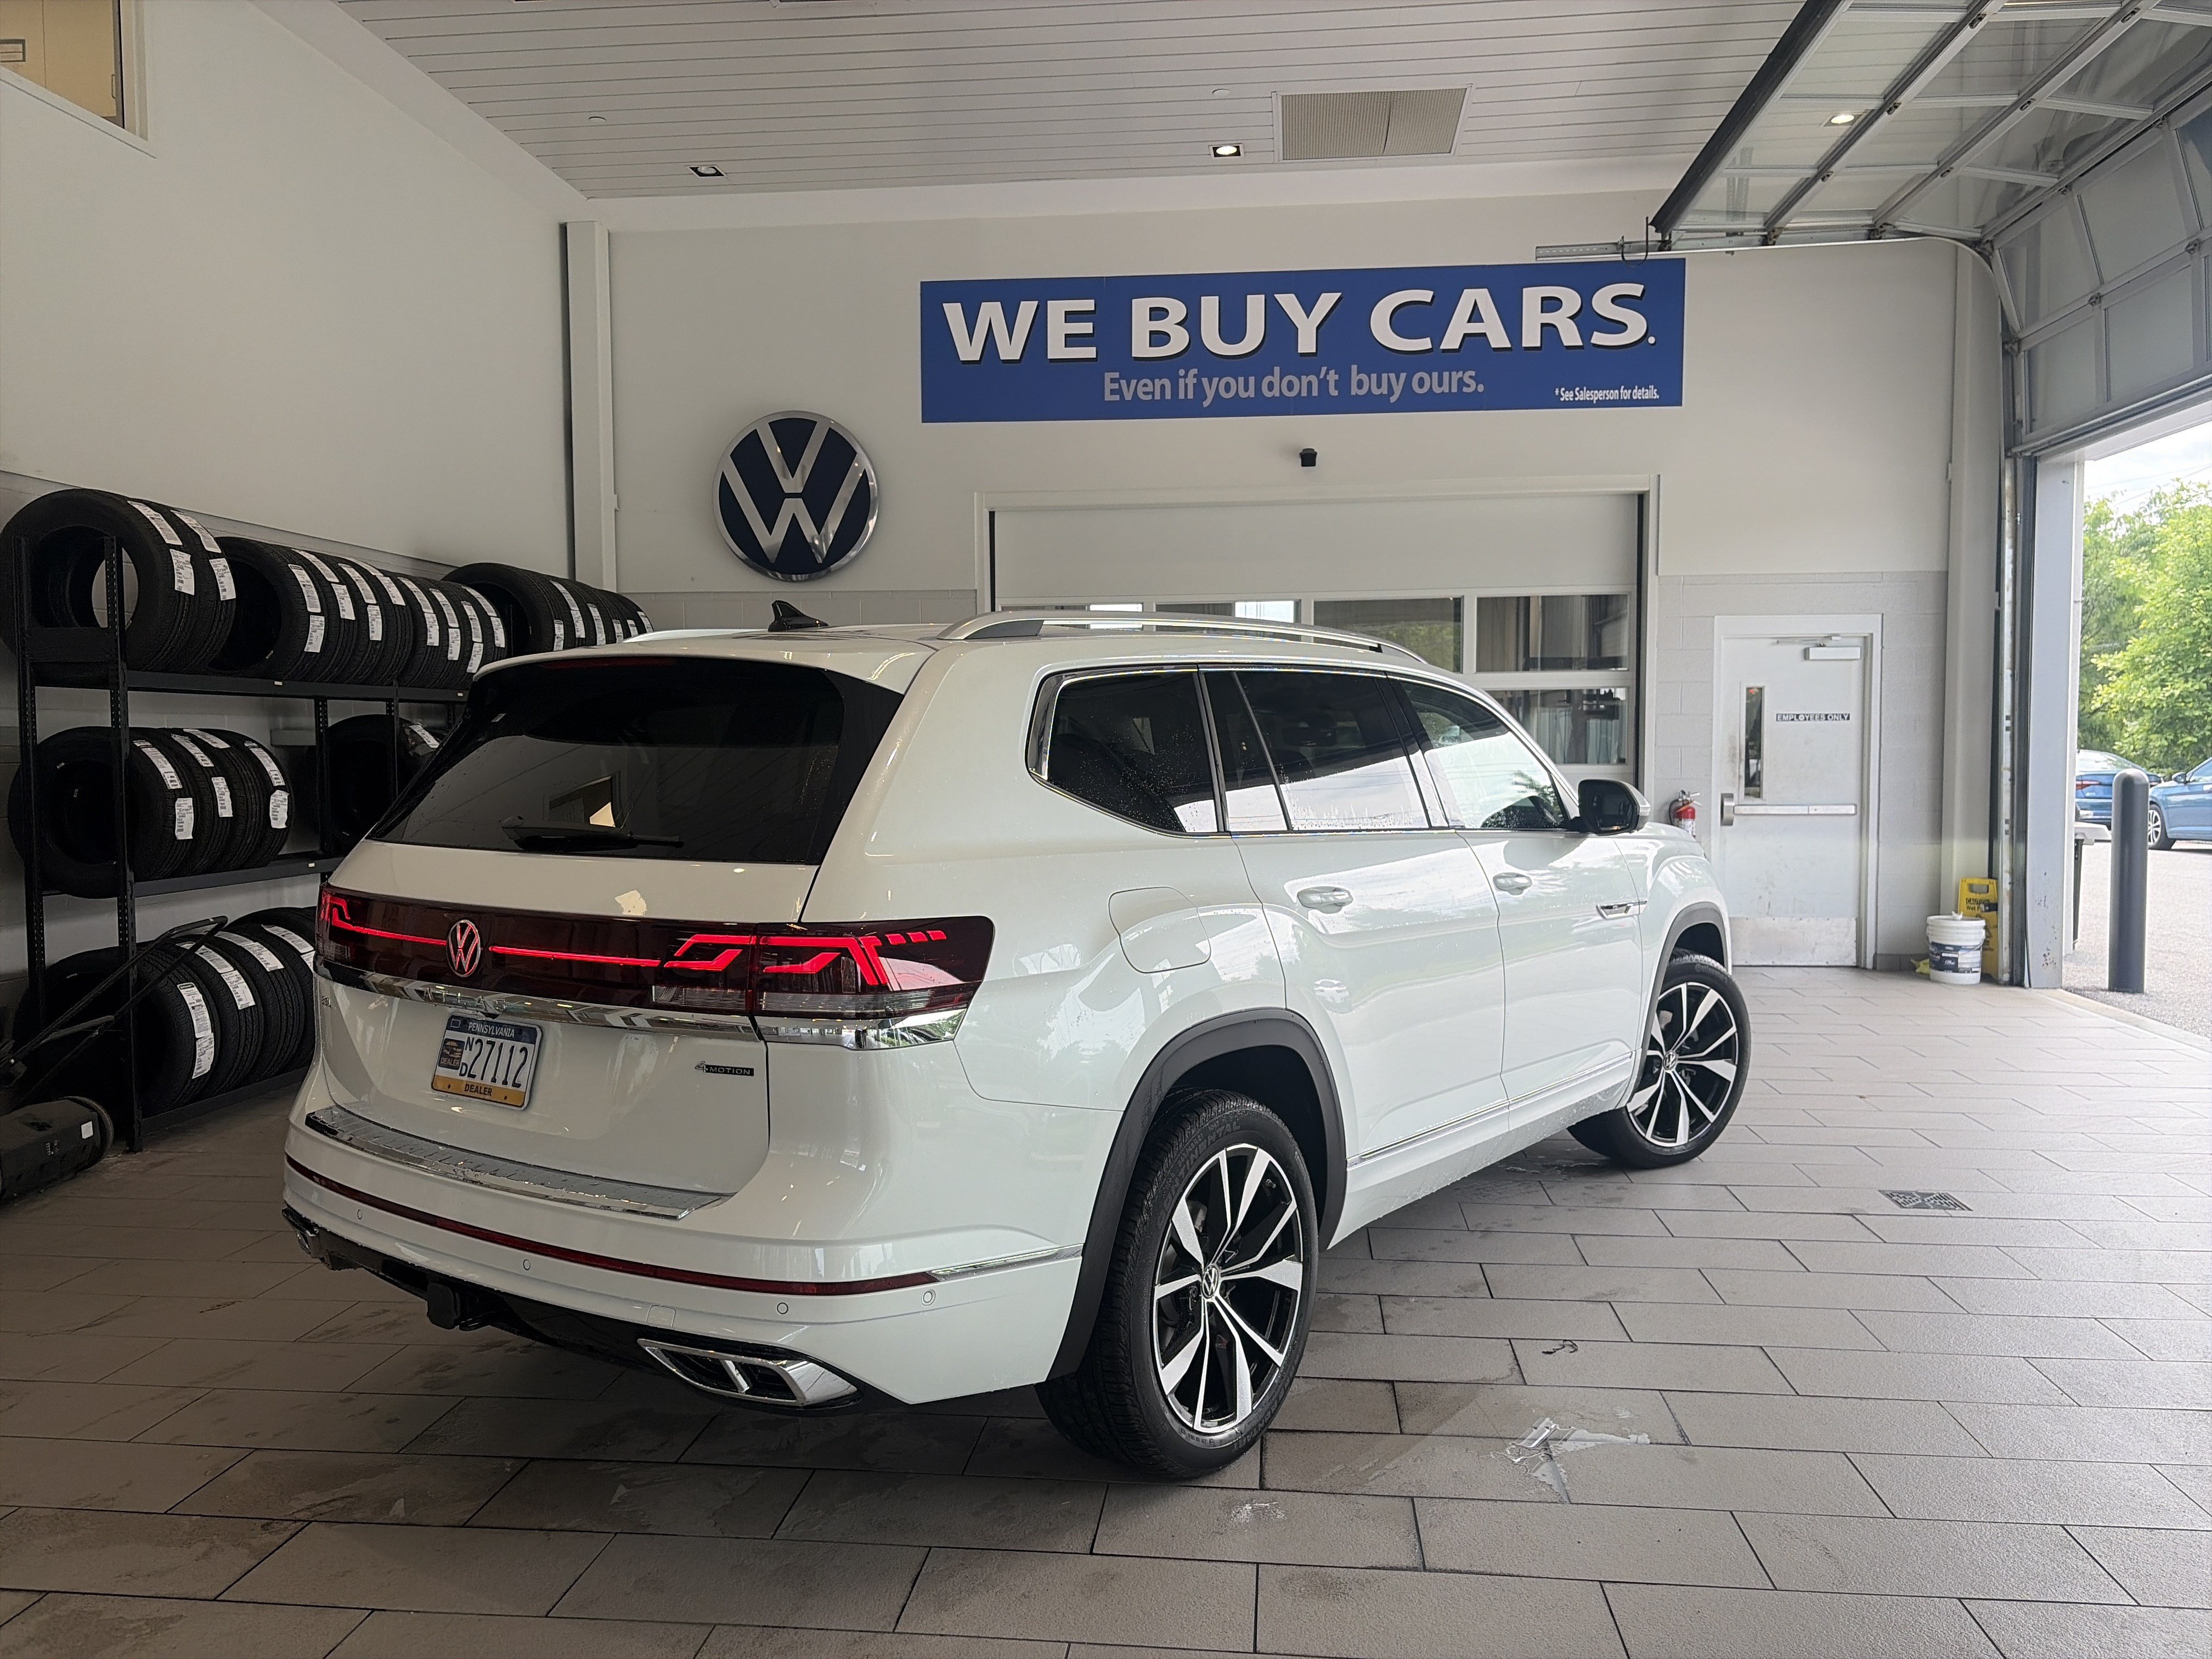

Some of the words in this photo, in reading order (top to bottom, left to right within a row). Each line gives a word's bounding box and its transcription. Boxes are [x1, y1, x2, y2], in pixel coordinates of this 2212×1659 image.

[943, 300, 1097, 362] WE
[1131, 292, 1342, 359] BUY
[1370, 283, 1656, 352] CARS.
[1104, 371, 1171, 401] Even
[1178, 369, 1199, 399] if
[1202, 374, 1255, 407] you
[1261, 366, 1339, 397] don’t
[1350, 364, 1407, 403] buy
[1412, 369, 1484, 394] ours.
[1575, 386, 1618, 404] Salesperson
[1620, 385, 1632, 400] for
[1632, 385, 1660, 399] details.
[1777, 713, 1826, 721] EMPLOYEES
[1827, 713, 1850, 721] ONLY
[468, 1022, 515, 1038] PENNSYLVANIA
[441, 1057, 460, 1066] DEALER
[464, 1084, 493, 1096] DEALER
